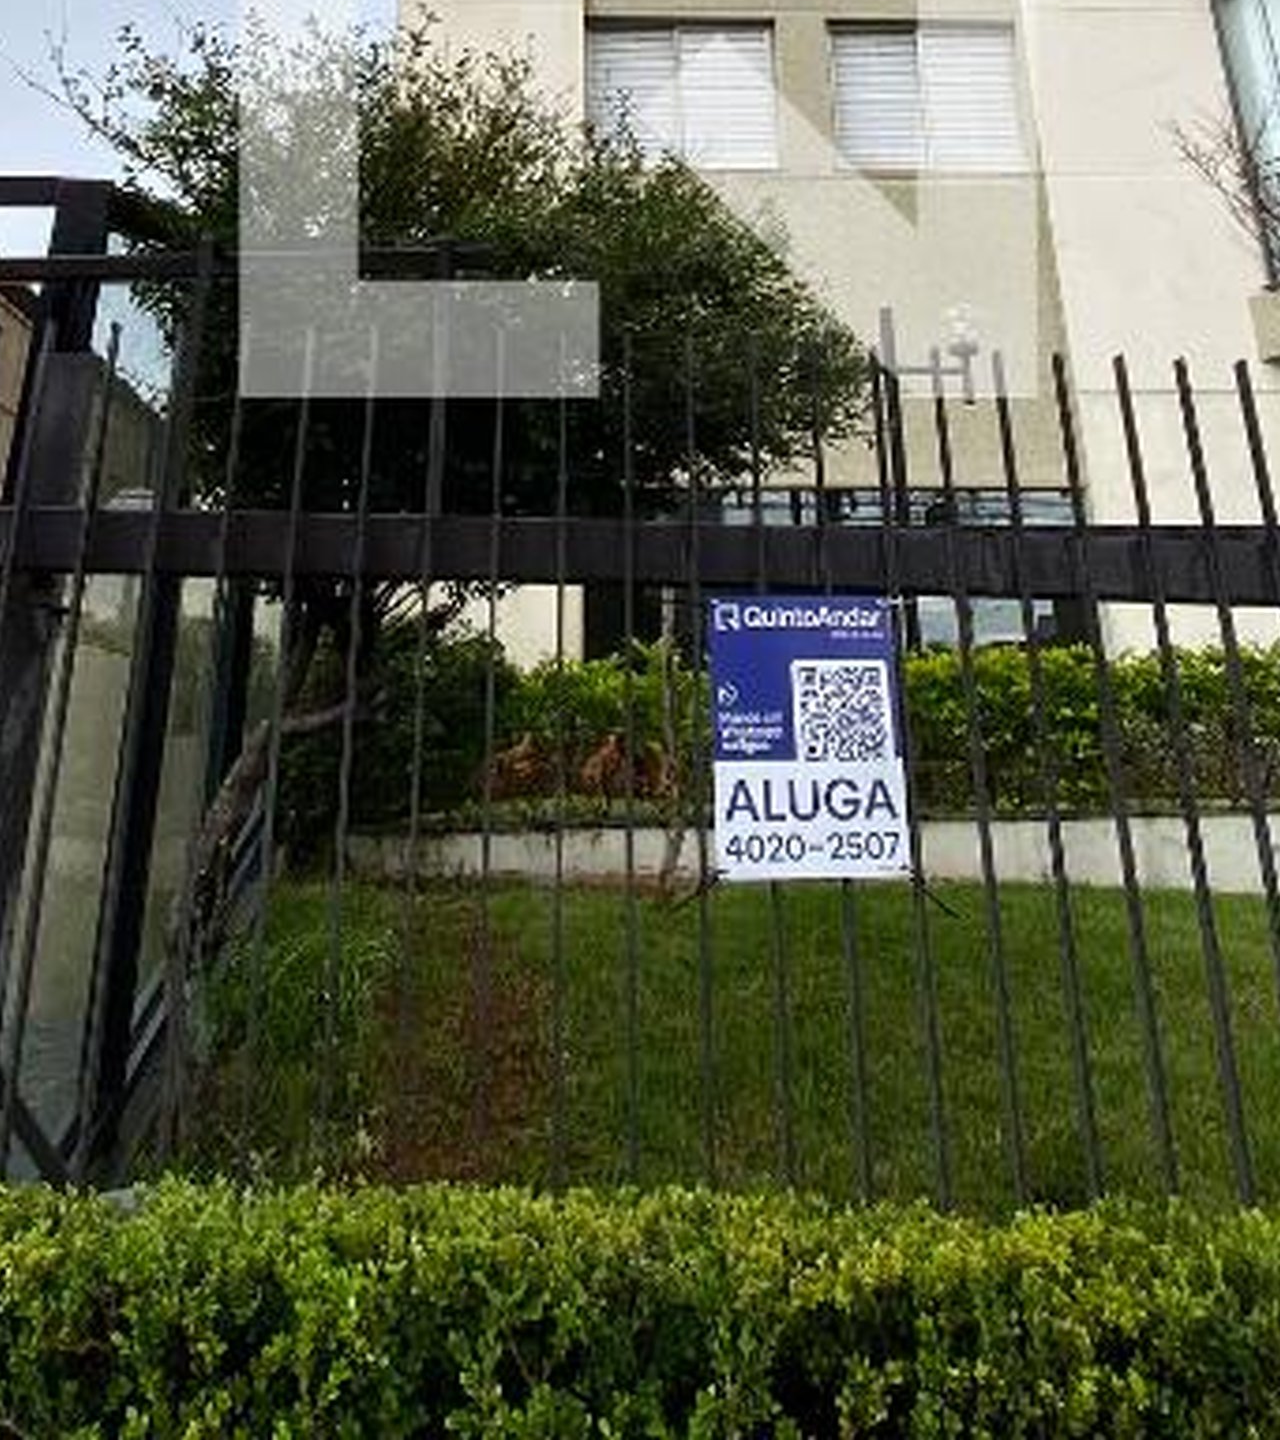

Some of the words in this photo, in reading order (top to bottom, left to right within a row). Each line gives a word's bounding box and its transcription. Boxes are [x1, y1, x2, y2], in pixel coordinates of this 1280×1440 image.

[742, 605, 880, 628] QuintoAndar
[725, 779, 898, 822] ALUGA
[725, 831, 900, 863] 4020-2507
